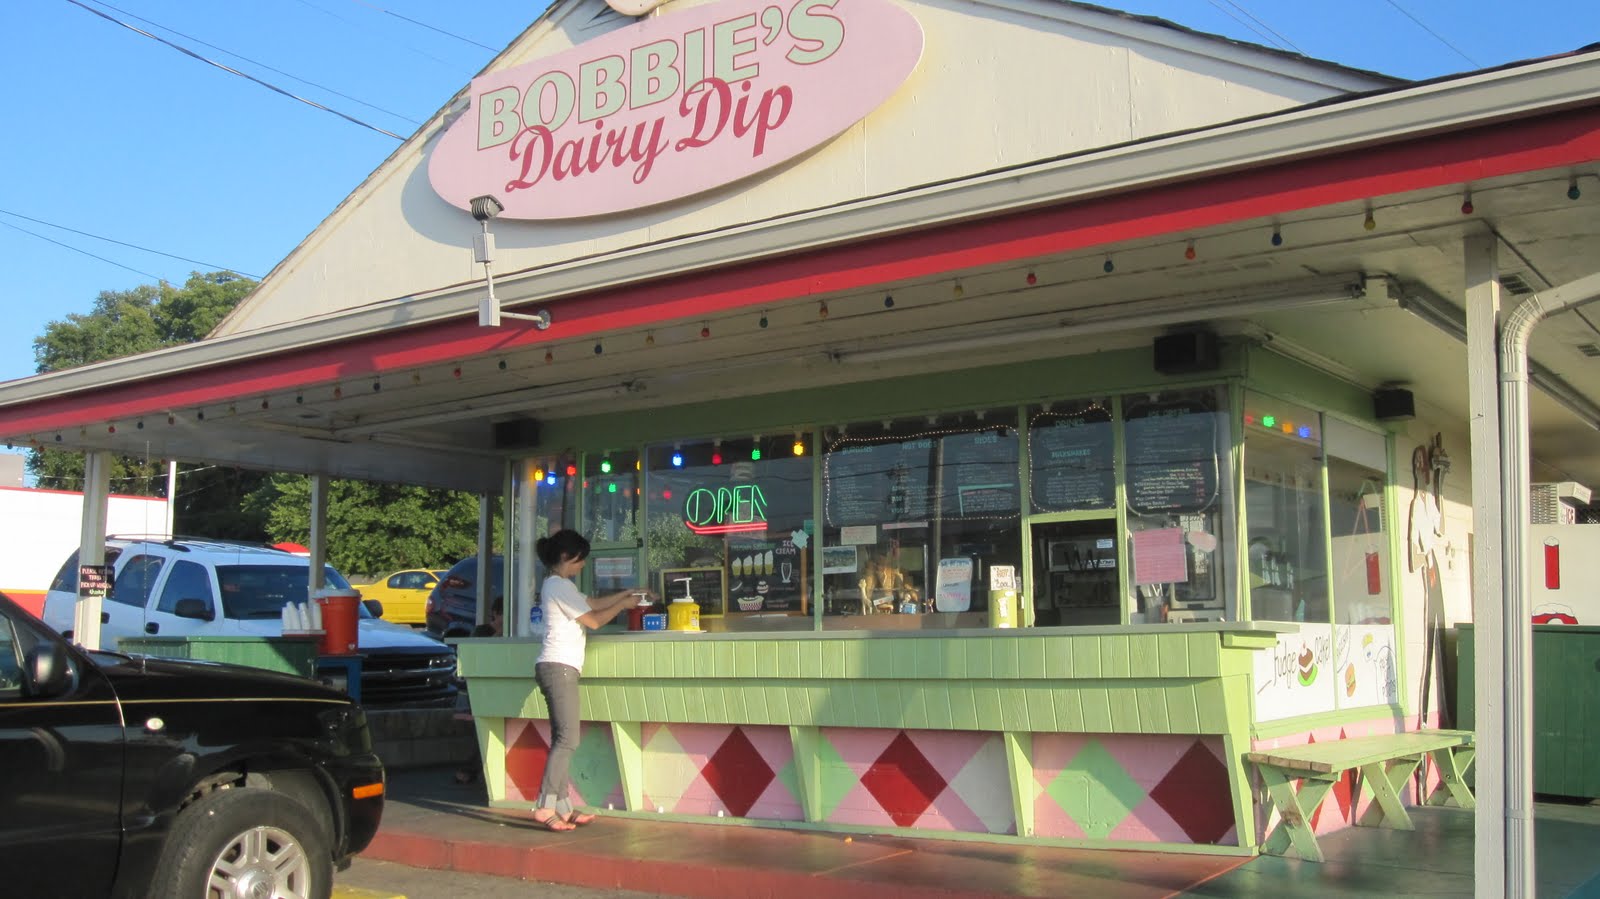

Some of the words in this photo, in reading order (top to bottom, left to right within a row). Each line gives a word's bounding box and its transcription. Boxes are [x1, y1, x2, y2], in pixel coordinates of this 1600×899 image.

[476, 0, 846, 151] BOBBIE'S
[505, 117, 669, 192] Dairy
[675, 77, 793, 157] Dip
[902, 442, 916, 450] HOT
[974, 435, 997, 444] SIDES
[686, 484, 768, 525] OPEN
[775, 548, 796, 556] CREAM
